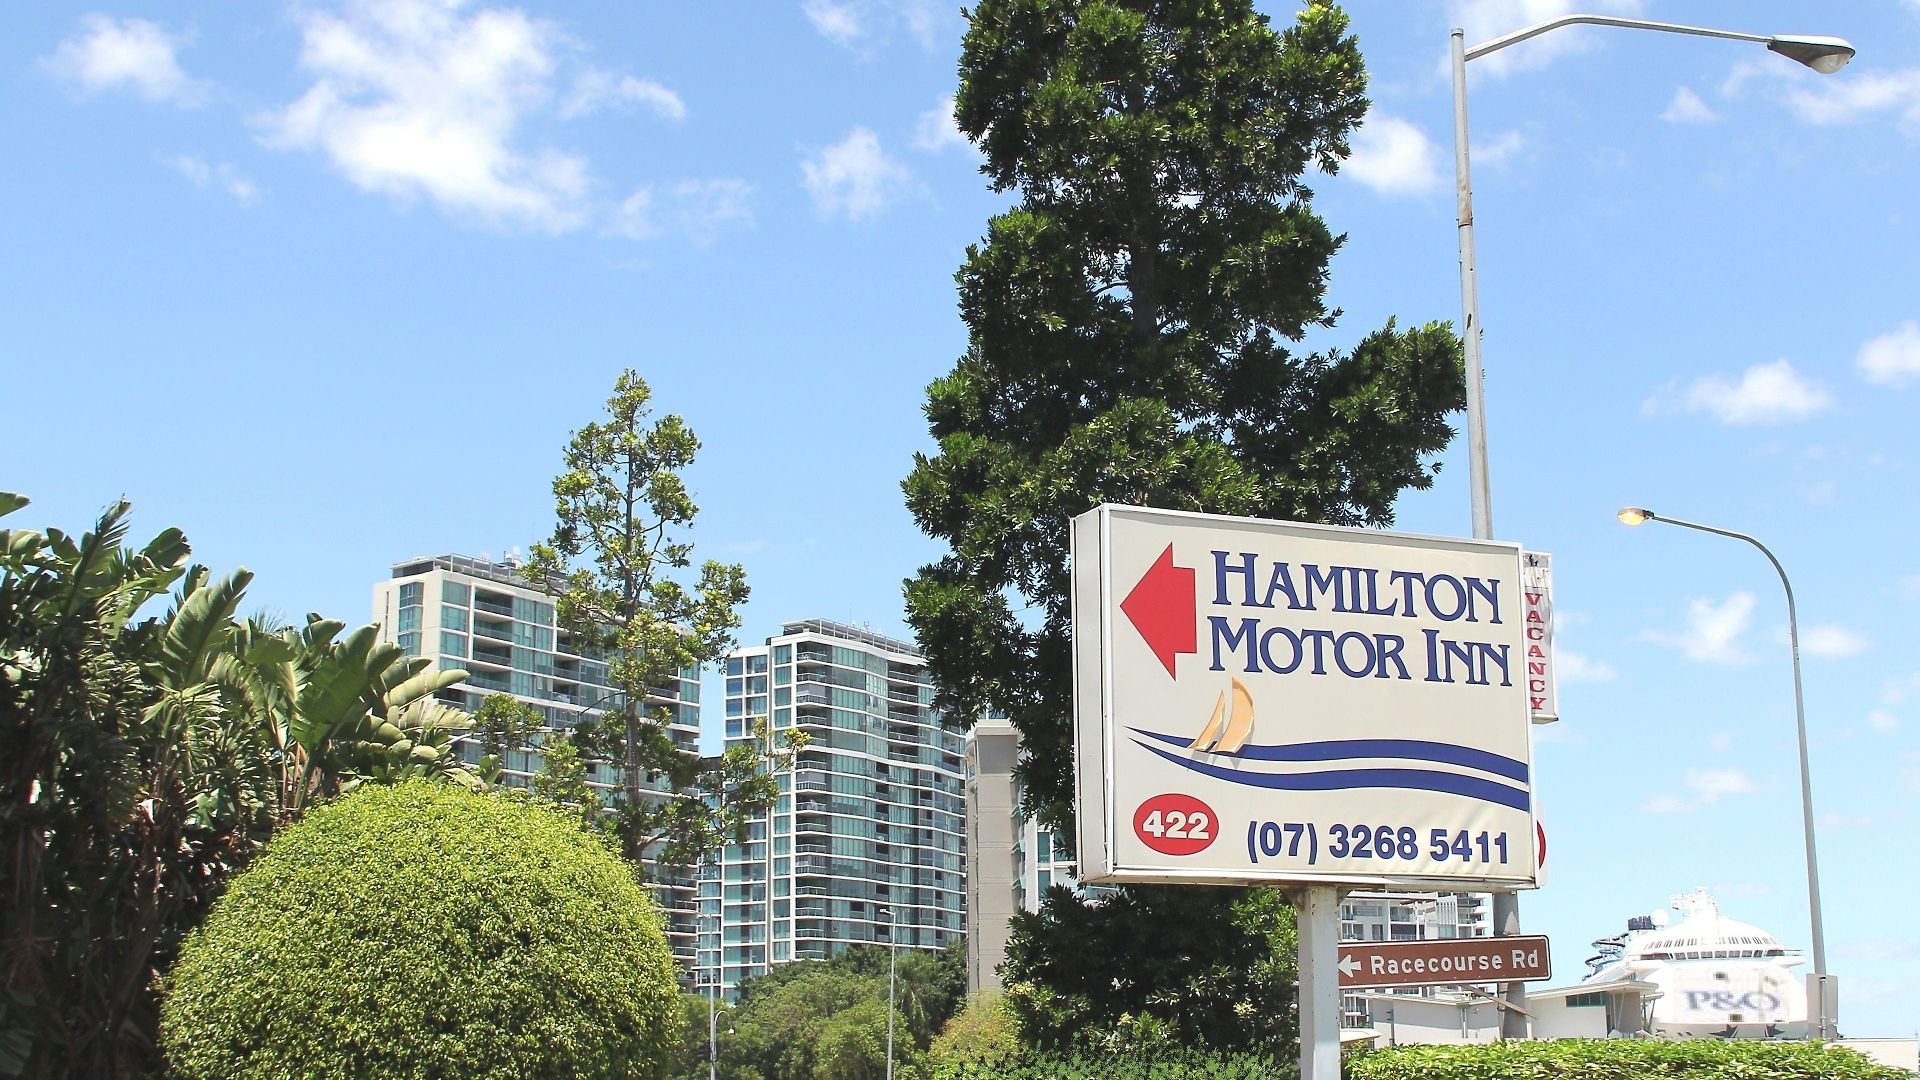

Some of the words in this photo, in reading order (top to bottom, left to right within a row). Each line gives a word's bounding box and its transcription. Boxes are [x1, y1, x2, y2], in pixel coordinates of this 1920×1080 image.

[1211, 550, 1503, 625] HAMILTON
[1208, 616, 1412, 679] MOTOR
[1422, 628, 1513, 687] INN
[1525, 592, 1546, 711] VACANCY
[1142, 809, 1210, 841] 422
[1247, 820, 1318, 865] (07)
[1328, 823, 1419, 861] 3268
[1429, 829, 1509, 865] 5411
[1370, 953, 1502, 976] Racecourse
[1511, 948, 1539, 969] Rd
[1684, 990, 1781, 1011] P&O
